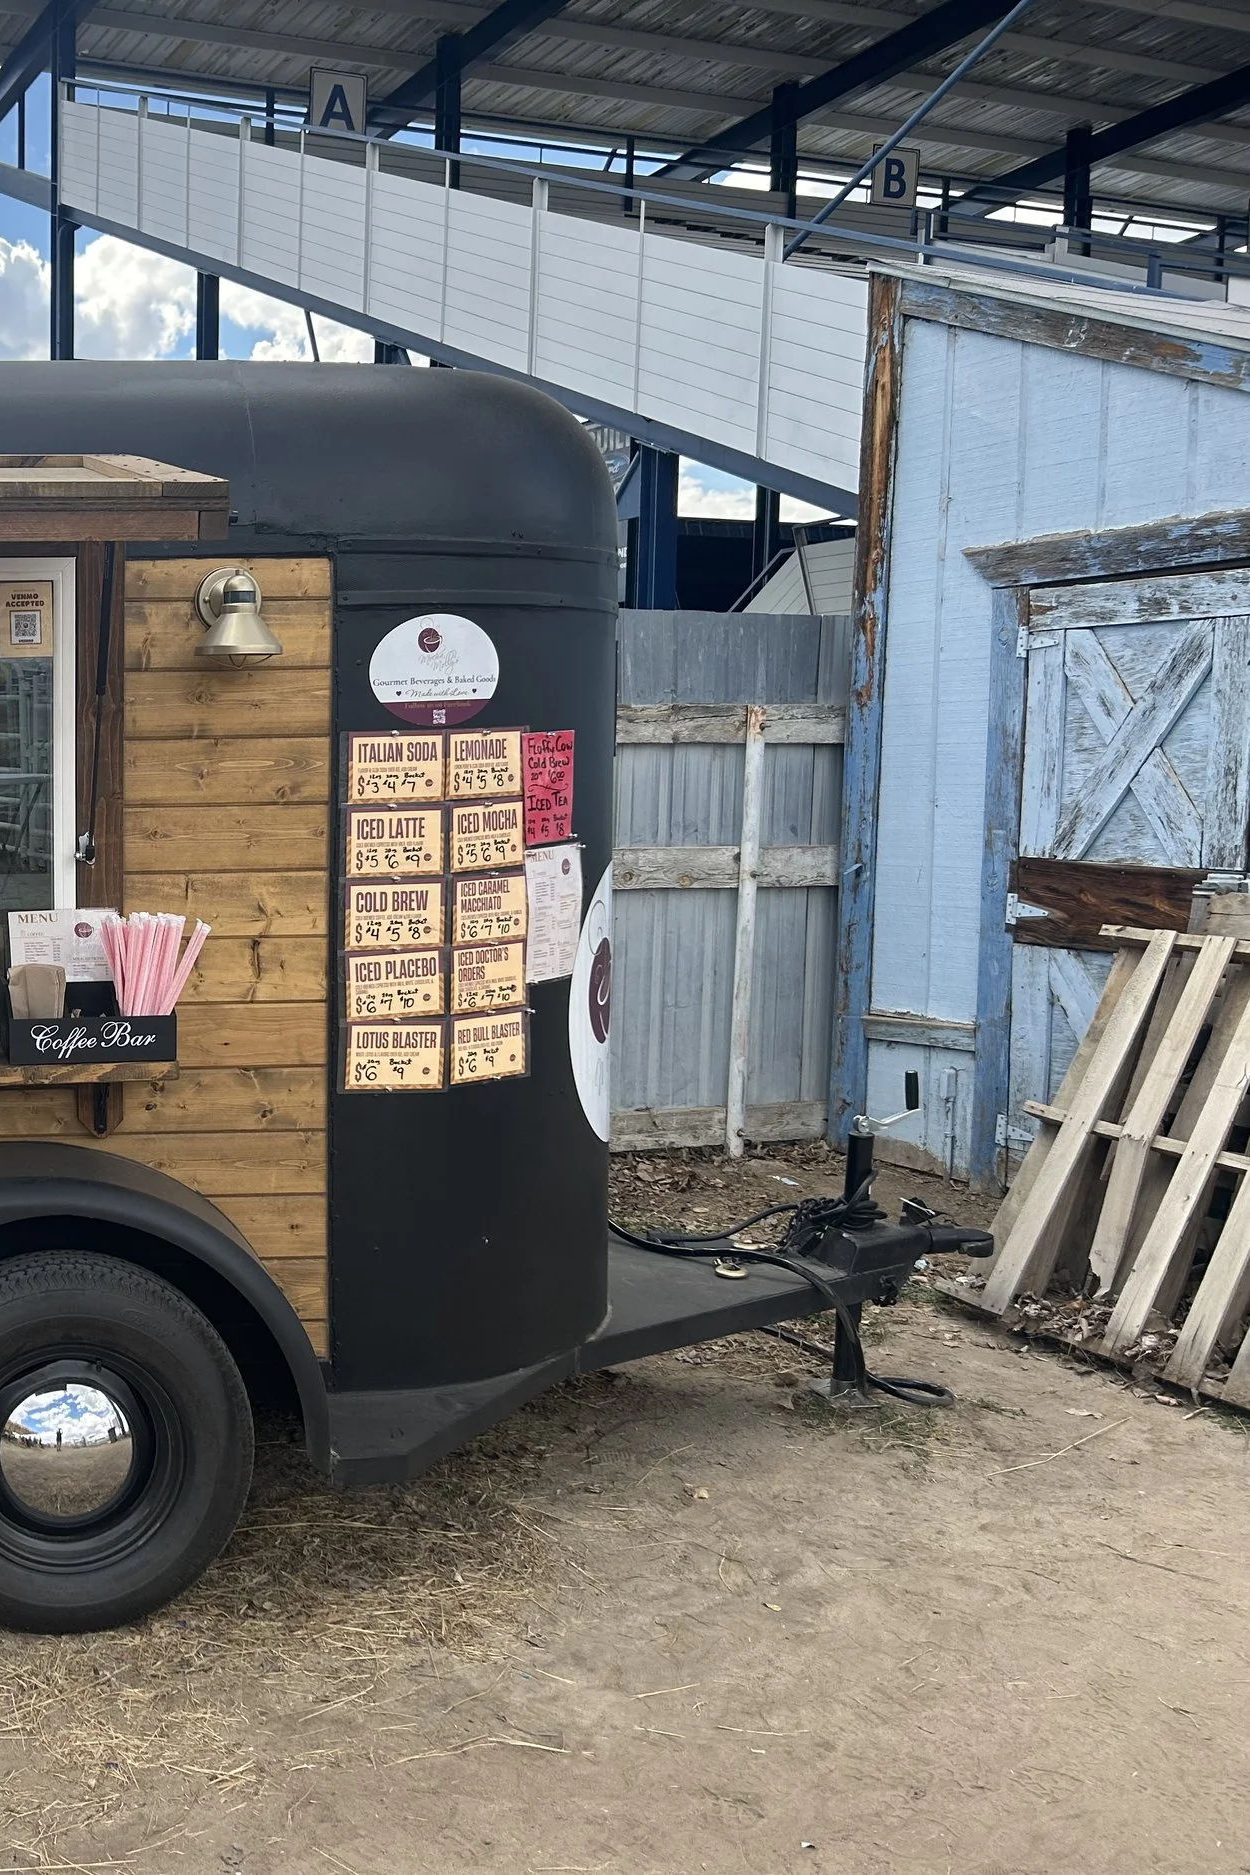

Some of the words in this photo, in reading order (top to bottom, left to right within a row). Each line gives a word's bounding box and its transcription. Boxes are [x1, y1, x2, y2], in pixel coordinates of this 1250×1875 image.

[319, 84, 355, 131] A
[883, 157, 907, 199] B
[6, 600, 45, 608] ACCEPTED
[372, 679, 408, 687] Gourmet
[410, 677, 445, 686] Beverages
[447, 676, 453, 684] &
[454, 675, 475, 684] Baked
[476, 675, 496, 683] Goods
[358, 742, 403, 763] ITALIAN
[407, 741, 438, 762] SODA
[454, 738, 507, 762] LEMONADE
[555, 735, 573, 752] Cow
[528, 756, 547, 770] Cold
[549, 756, 570, 769] Brew
[527, 795, 552, 812] ICED
[551, 791, 568, 807] TEA
[356, 818, 385, 840] ICED
[389, 816, 426, 839] LATTE
[457, 812, 479, 835] ICED
[483, 808, 517, 831] MOCHA
[541, 824, 549, 838] $5
[365, 855, 379, 868] $5
[385, 854, 399, 869] $6
[405, 854, 420, 868] $9
[466, 849, 478, 863] $5
[495, 845, 505, 860] $9
[460, 882, 477, 898] ICED
[478, 879, 510, 896] CARAMEL
[355, 892, 387, 914] COLD
[392, 890, 429, 912] BREW
[460, 895, 502, 914] MACCHIATO
[17, 913, 59, 924] MENU
[366, 927, 379, 941] $4
[386, 926, 400, 942] $5
[408, 926, 421, 940] $8
[498, 924, 510, 935] $10
[457, 952, 474, 967] ICED
[475, 947, 509, 965] DOCTOR'S
[355, 961, 381, 983] ICED
[385, 957, 437, 980] PLACEBO
[458, 965, 485, 983] ORDERS
[362, 1000, 377, 1014] $6
[380, 999, 393, 1011] $7
[400, 996, 414, 1009] $10
[497, 993, 510, 1001] $10
[30, 1024, 98, 1059] Coffee
[100, 1021, 157, 1048] Bar
[356, 1030, 389, 1049] LOTUS
[392, 1031, 437, 1049] BLASTER
[457, 1029, 471, 1045] RED
[473, 1026, 490, 1043] BULL
[492, 1021, 520, 1040] BLASTER
[361, 1064, 377, 1081] $6
[393, 1066, 404, 1080] $9
